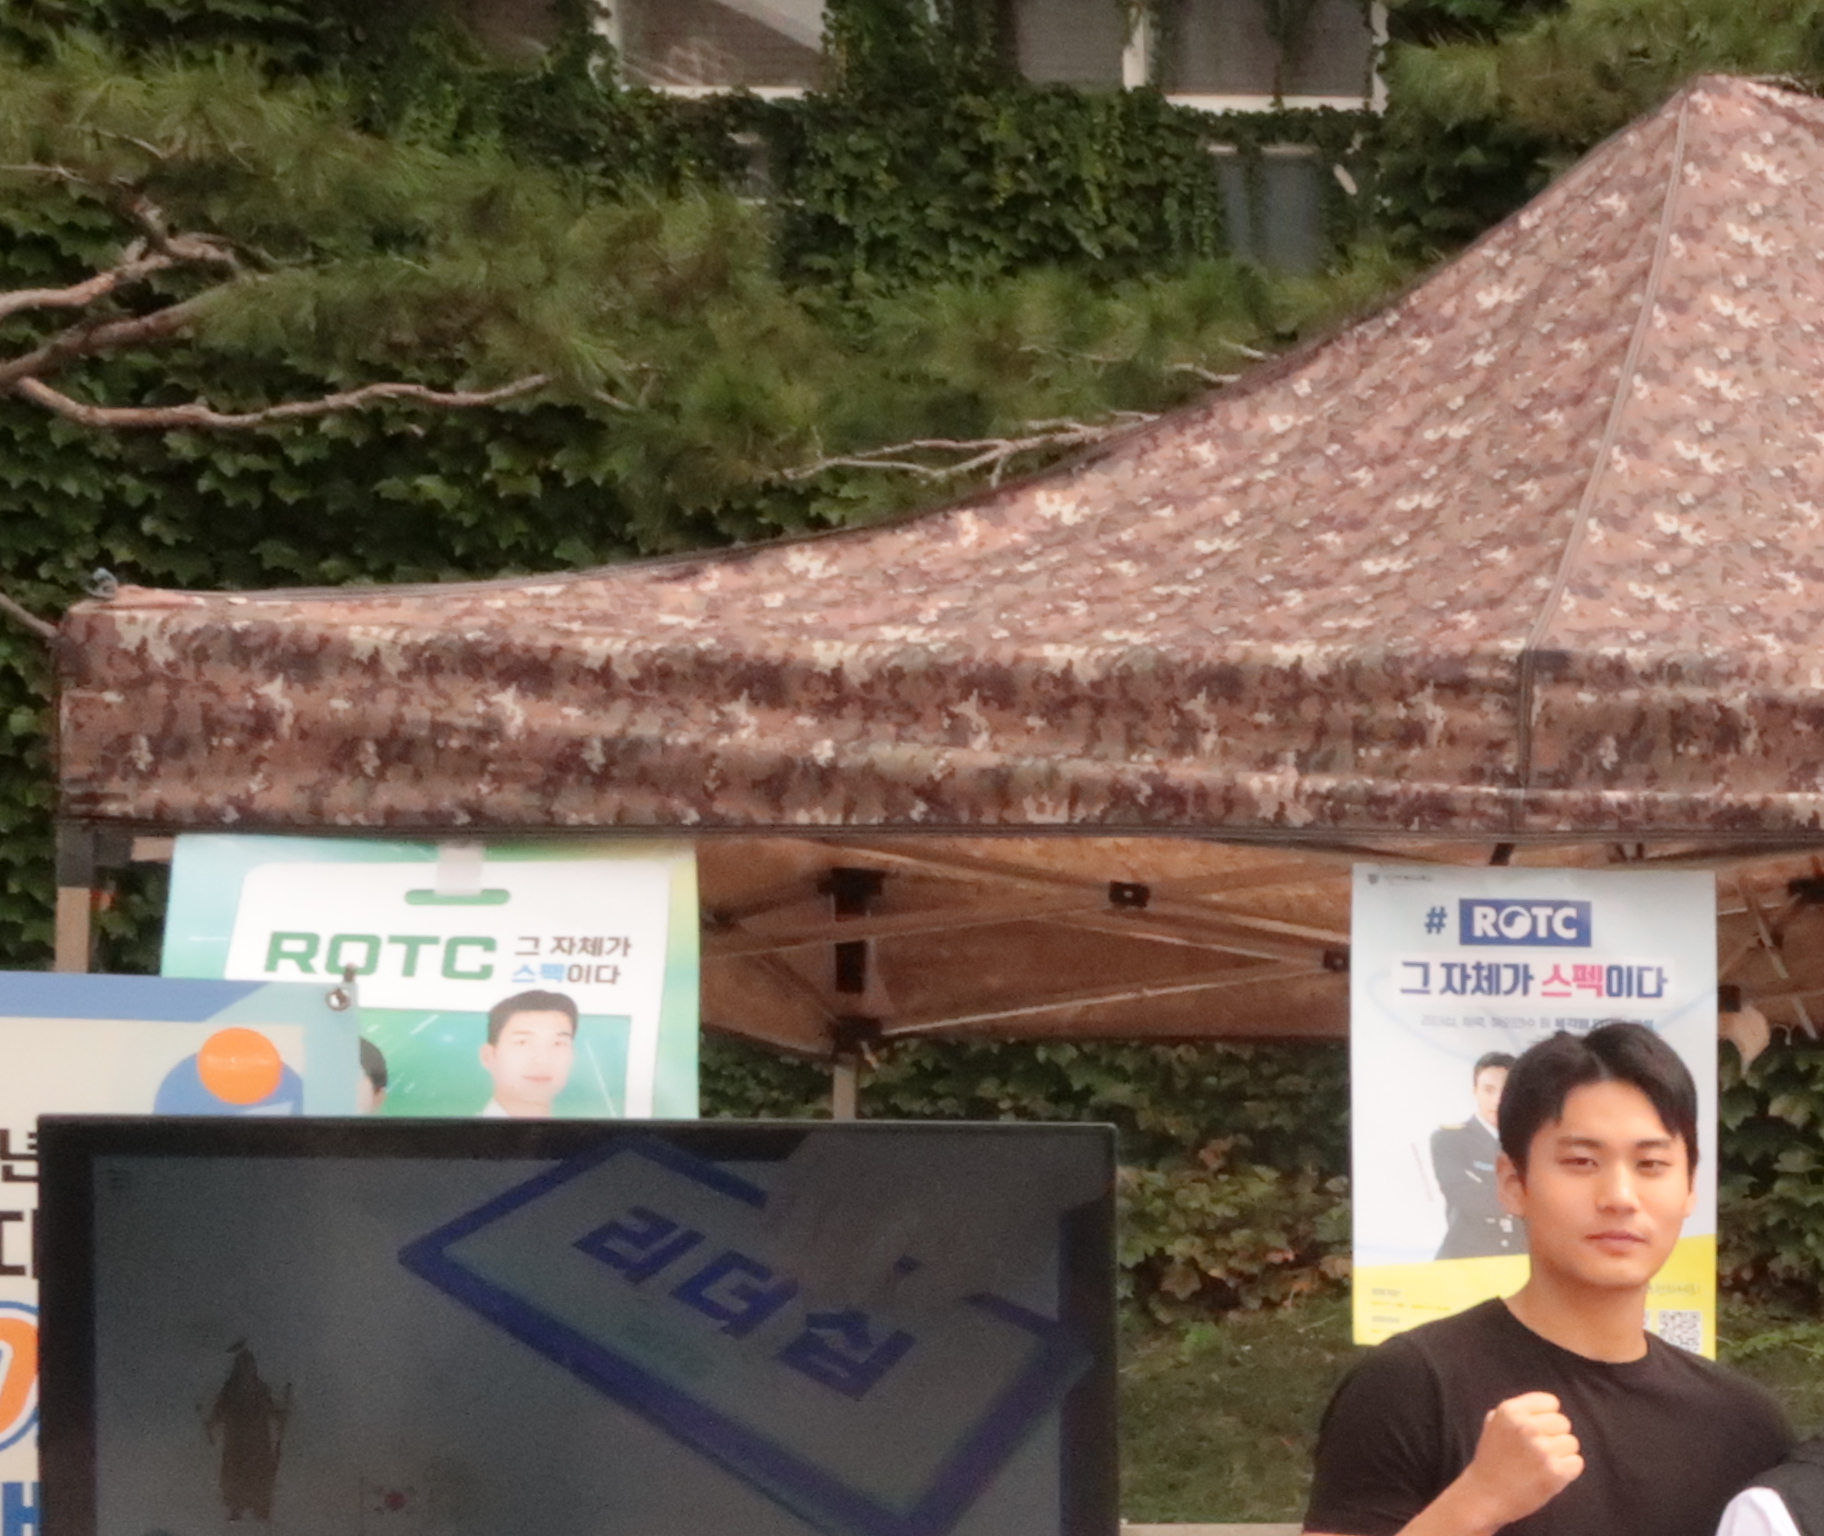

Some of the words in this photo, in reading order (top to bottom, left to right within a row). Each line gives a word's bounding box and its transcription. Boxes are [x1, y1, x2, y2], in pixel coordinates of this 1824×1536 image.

[1472, 904, 1578, 941] ROTC
[263, 930, 498, 981] ROTC
[514, 936, 542, 957] 그
[550, 935, 632, 959] 자체가
[511, 961, 621, 987] 스펙이다
[1400, 961, 1431, 996] 그
[1439, 960, 1535, 997] 자체가
[1541, 962, 1669, 1000] 스펙이다
